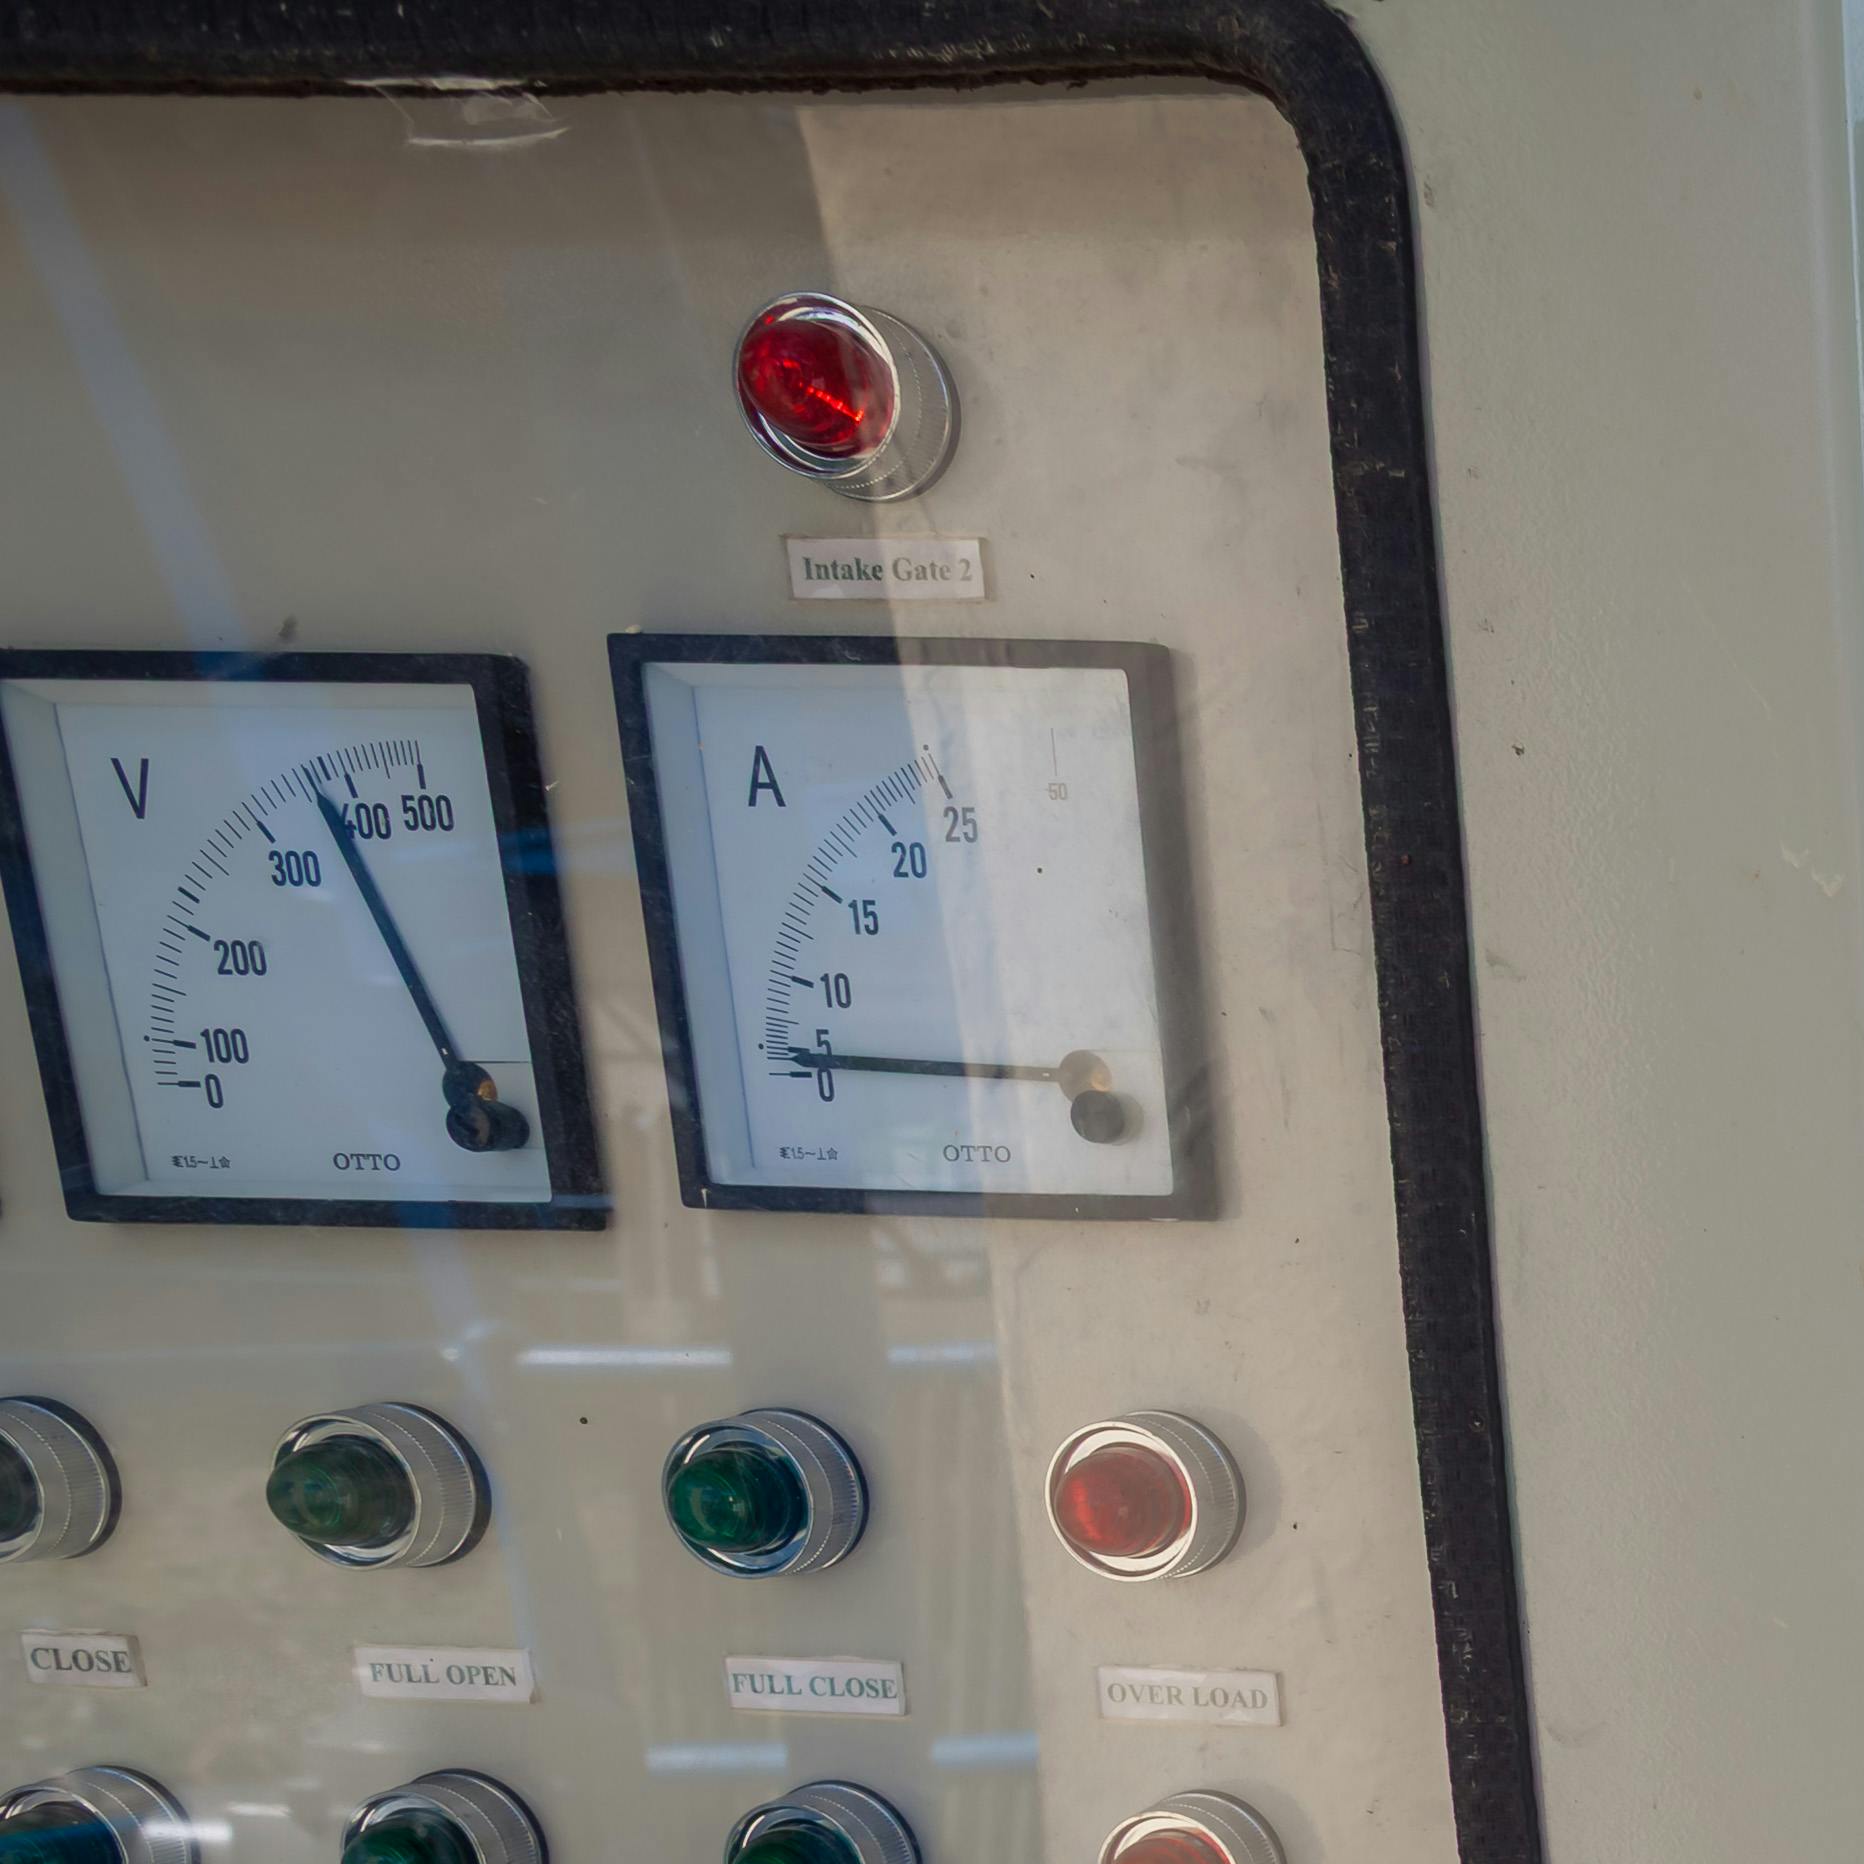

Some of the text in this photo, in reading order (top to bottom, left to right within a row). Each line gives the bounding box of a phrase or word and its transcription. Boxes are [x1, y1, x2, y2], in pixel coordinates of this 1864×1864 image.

[803, 557, 973, 581] Intake Gate 2
[110, 757, 149, 819] V
[747, 745, 786, 807] A
[1047, 782, 1068, 801] 50
[400, 794, 454, 832] 500
[943, 806, 979, 843] 25
[268, 850, 321, 887] 300
[891, 842, 927, 879] 20
[848, 899, 879, 936] 15
[213, 940, 267, 977] 200
[820, 973, 852, 1009] 10
[200, 1028, 249, 1065] 100
[815, 1028, 834, 1056] 5
[204, 1074, 224, 1109] 0
[817, 1067, 835, 1103] 0
[333, 1153, 401, 1171] OTTO
[943, 1144, 1011, 1163] OTTO
[29, 1646, 131, 1674] CLOSE
[369, 1662, 517, 1688] FULL OPEN
[731, 1673, 898, 1700] FULL CLOSE
[1107, 1681, 1269, 1711] OVER LOAD
